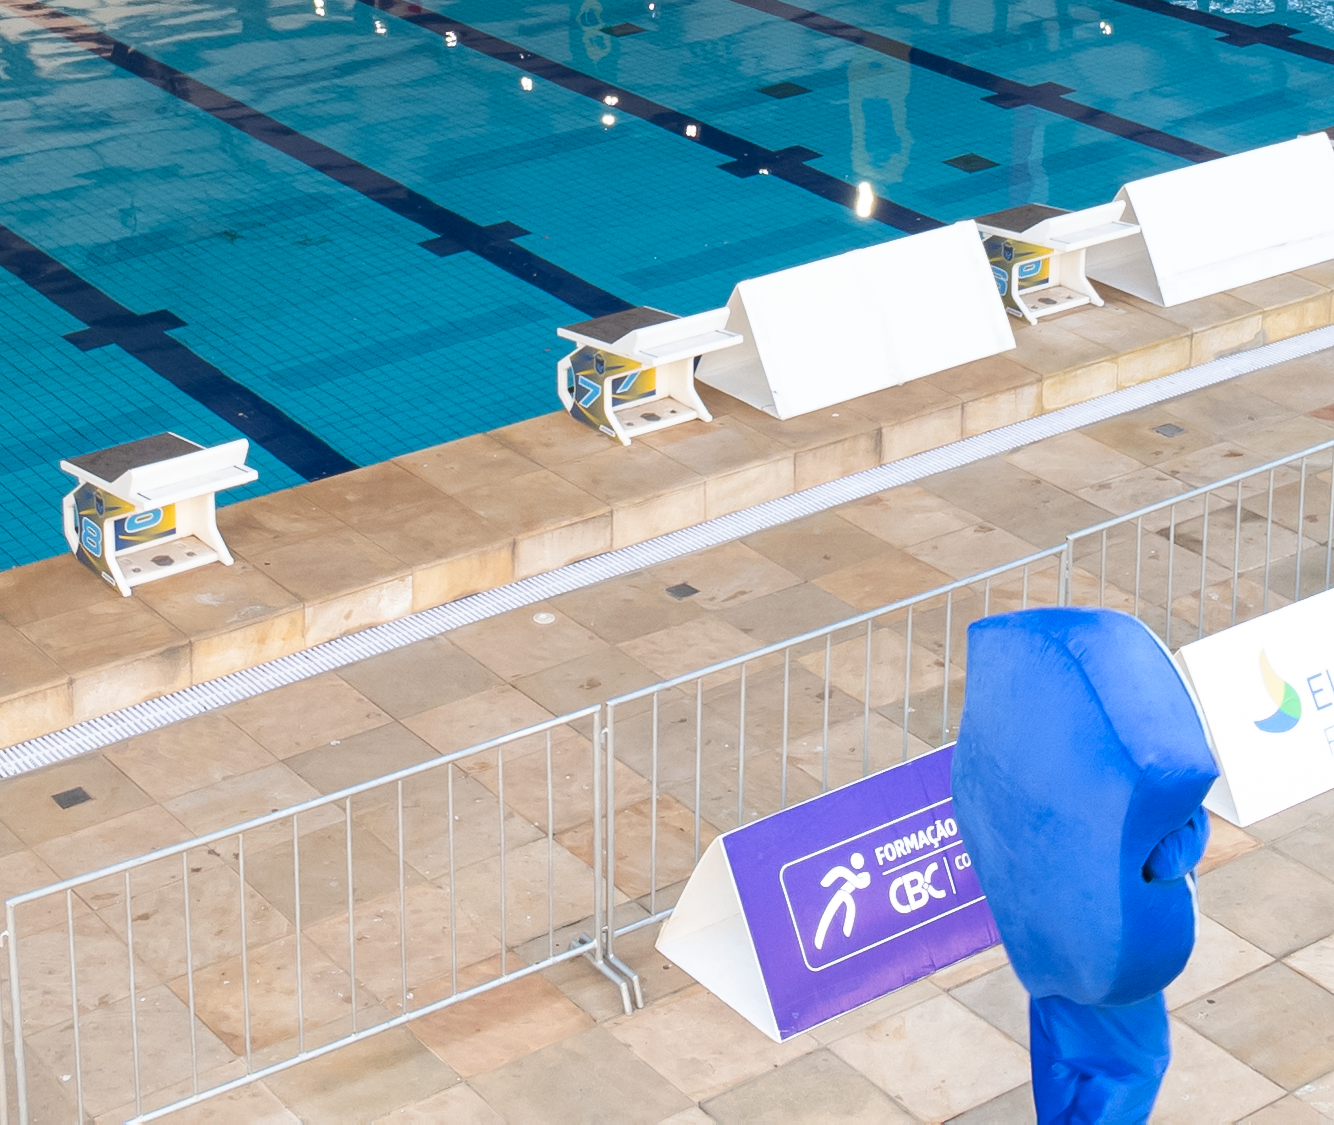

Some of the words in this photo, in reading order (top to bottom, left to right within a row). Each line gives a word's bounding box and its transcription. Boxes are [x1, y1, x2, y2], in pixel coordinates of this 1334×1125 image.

[578, 374, 602, 409] 7
[81, 516, 103, 559] 8
[874, 817, 958, 866] FORMAÇÃO
[888, 861, 947, 914] CBC
